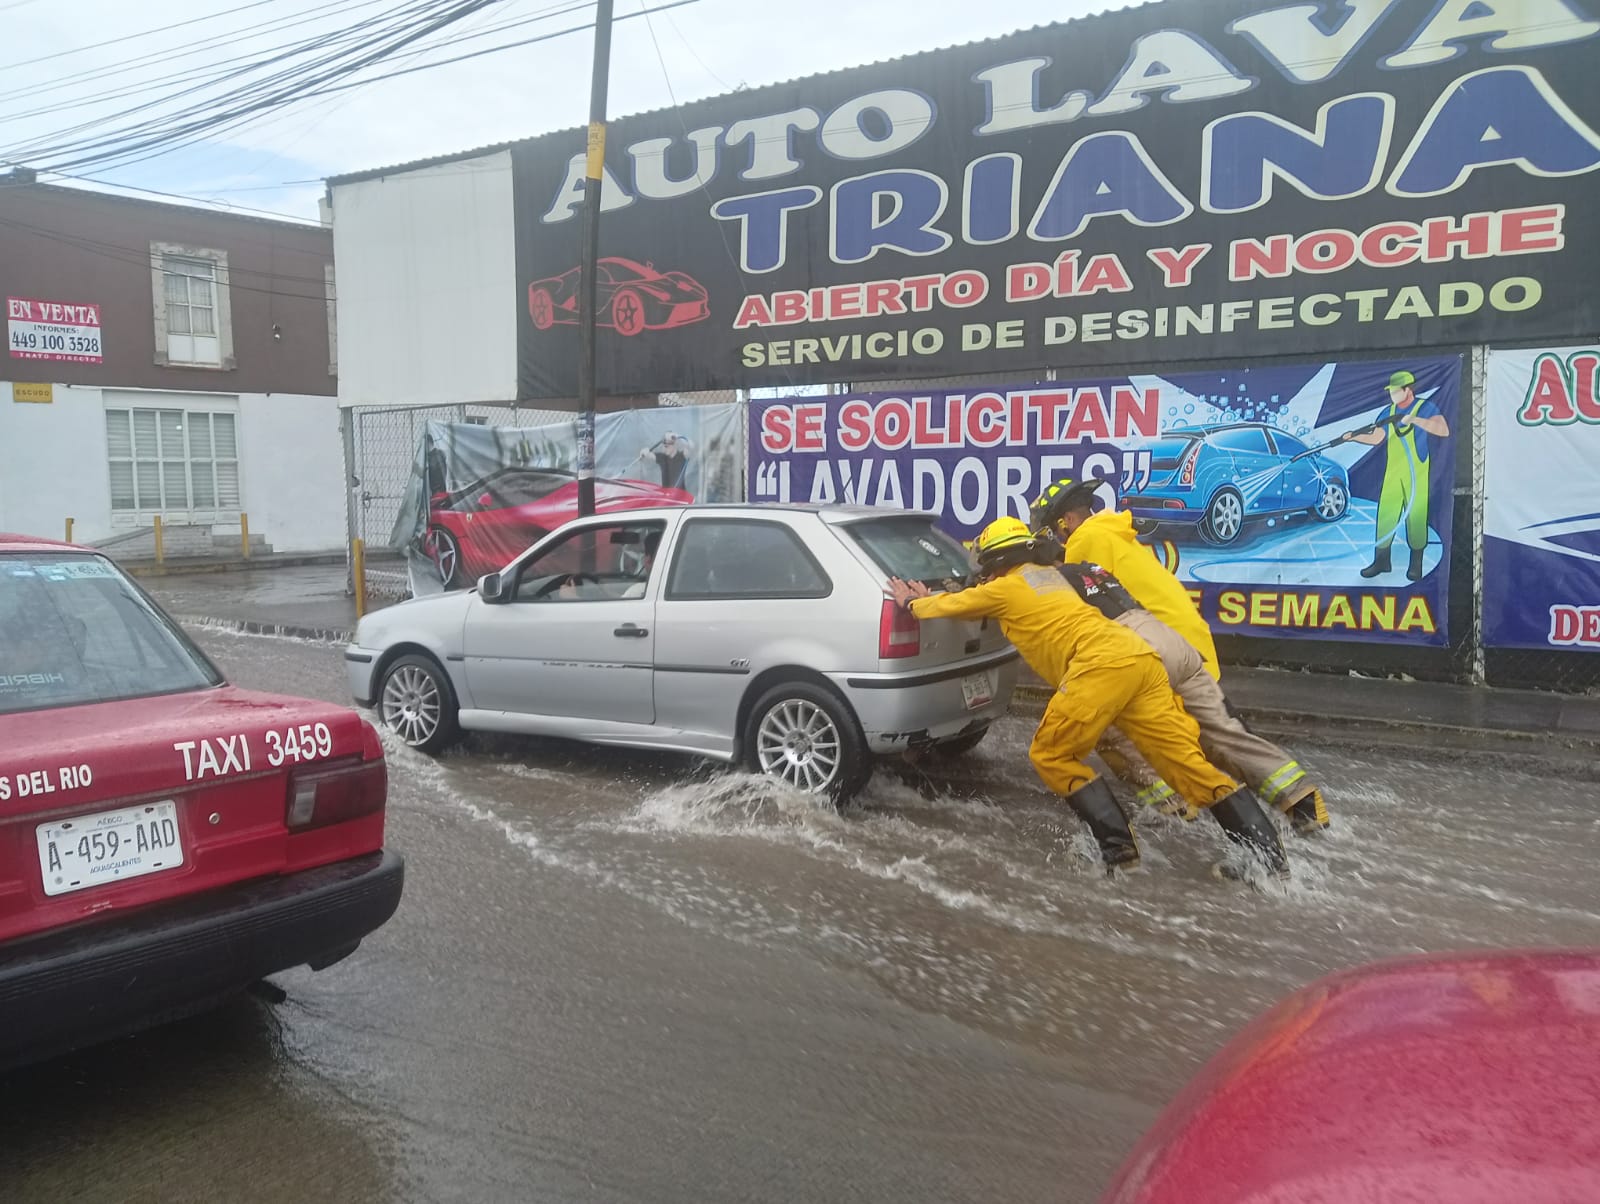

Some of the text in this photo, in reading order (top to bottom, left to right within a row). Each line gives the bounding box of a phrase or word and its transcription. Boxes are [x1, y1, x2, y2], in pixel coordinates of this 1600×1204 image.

[540, 0, 1600, 224] AUTO LAVA
[710, 64, 1600, 274] TRIANA
[733, 203, 1565, 329] ABIERTO DÍA Y NOCHE
[8, 299, 99, 325] EN VENTA
[742, 277, 1542, 367] SERVICIO DE DESINFECTADO
[12, 331, 99, 353] 449 100 3528
[56, 354, 97, 362] DIRECTO
[761, 385, 1162, 454] SE SOLICITAN
[1217, 591, 1436, 633] SEMANA
[174, 722, 333, 781] TAXI 3459
[16, 770, 56, 797] DEL
[59, 764, 92, 790] RIO
[48, 818, 176, 873] A-459-AAD
